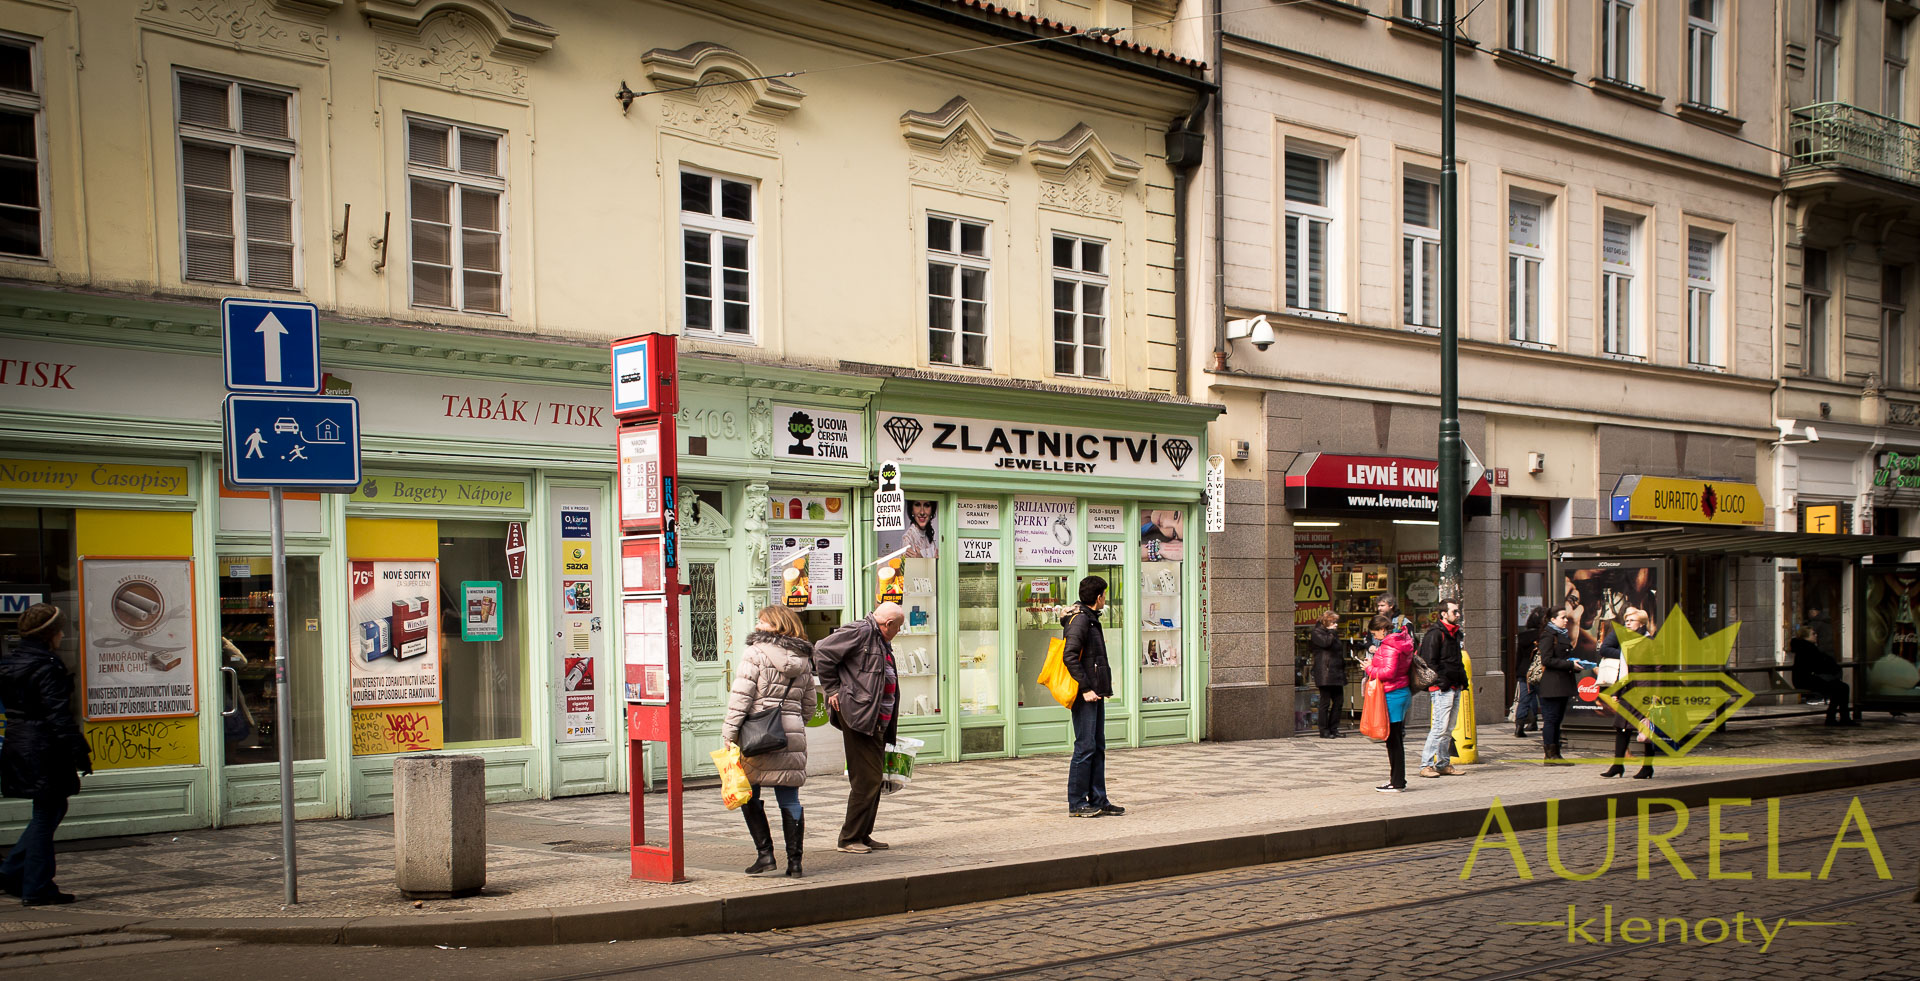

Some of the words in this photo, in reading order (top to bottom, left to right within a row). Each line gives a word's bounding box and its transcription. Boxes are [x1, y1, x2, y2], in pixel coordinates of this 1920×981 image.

[0, 359, 77, 390] TISK
[325, 387, 350, 396] Services
[442, 392, 528, 422] TABÁK
[534, 402, 541, 425] /
[549, 402, 604, 427] TISK
[791, 423, 812, 434] UGO
[817, 417, 847, 431] UGOVA
[817, 430, 848, 443] ČERSTVÁ
[932, 422, 1158, 463] ZLATNICTVÍ
[817, 442, 848, 458] ŠŤÁVA
[994, 457, 1096, 473] JEWELLERY
[0, 464, 78, 489] Noviny
[91, 463, 181, 493] Časopisy
[1347, 461, 1398, 486] LEVNÉ
[1403, 467, 1439, 488] KNI
[1874, 470, 1889, 486] U
[393, 481, 447, 502] Bagety
[457, 483, 512, 504] Nápoje
[876, 493, 901, 503] UGOVA
[1014, 500, 1075, 513] BRILIANTOVÉ
[1347, 493, 1439, 512] www.levneknihy.
[1655, 490, 1698, 511] BURRITO
[1720, 495, 1745, 513] LOCO
[572, 515, 588, 523] karta
[1014, 513, 1049, 526] ŠPERKY
[964, 539, 992, 550] VÝKUP
[1294, 533, 1309, 542] EVNÉ
[1092, 542, 1118, 552] VÝKUP
[965, 550, 991, 559] ZLATA
[1093, 552, 1117, 560] ZLATA
[354, 571, 368, 585] 76
[383, 569, 402, 579] NOVÉ
[404, 570, 431, 579] SOFTKY
[0, 595, 30, 612] M
[98, 659, 125, 673] JEMNÁ
[353, 677, 384, 688] MINISTERSTVO
[385, 675, 418, 687] ZDRAVOTNICTVÍ
[88, 686, 128, 700] MINISTERSTVO
[128, 683, 170, 698] ZDRAVOTNICTVÍ
[353, 689, 376, 701] KOUŘENÍ
[378, 688, 407, 700] ZPŮSOBUJE
[409, 687, 436, 698] RAKOVINU.
[88, 701, 118, 716] KOUŘENÍ
[119, 700, 157, 714] ZPŮSOBUJE
[158, 699, 192, 713] RAKOVINU.
